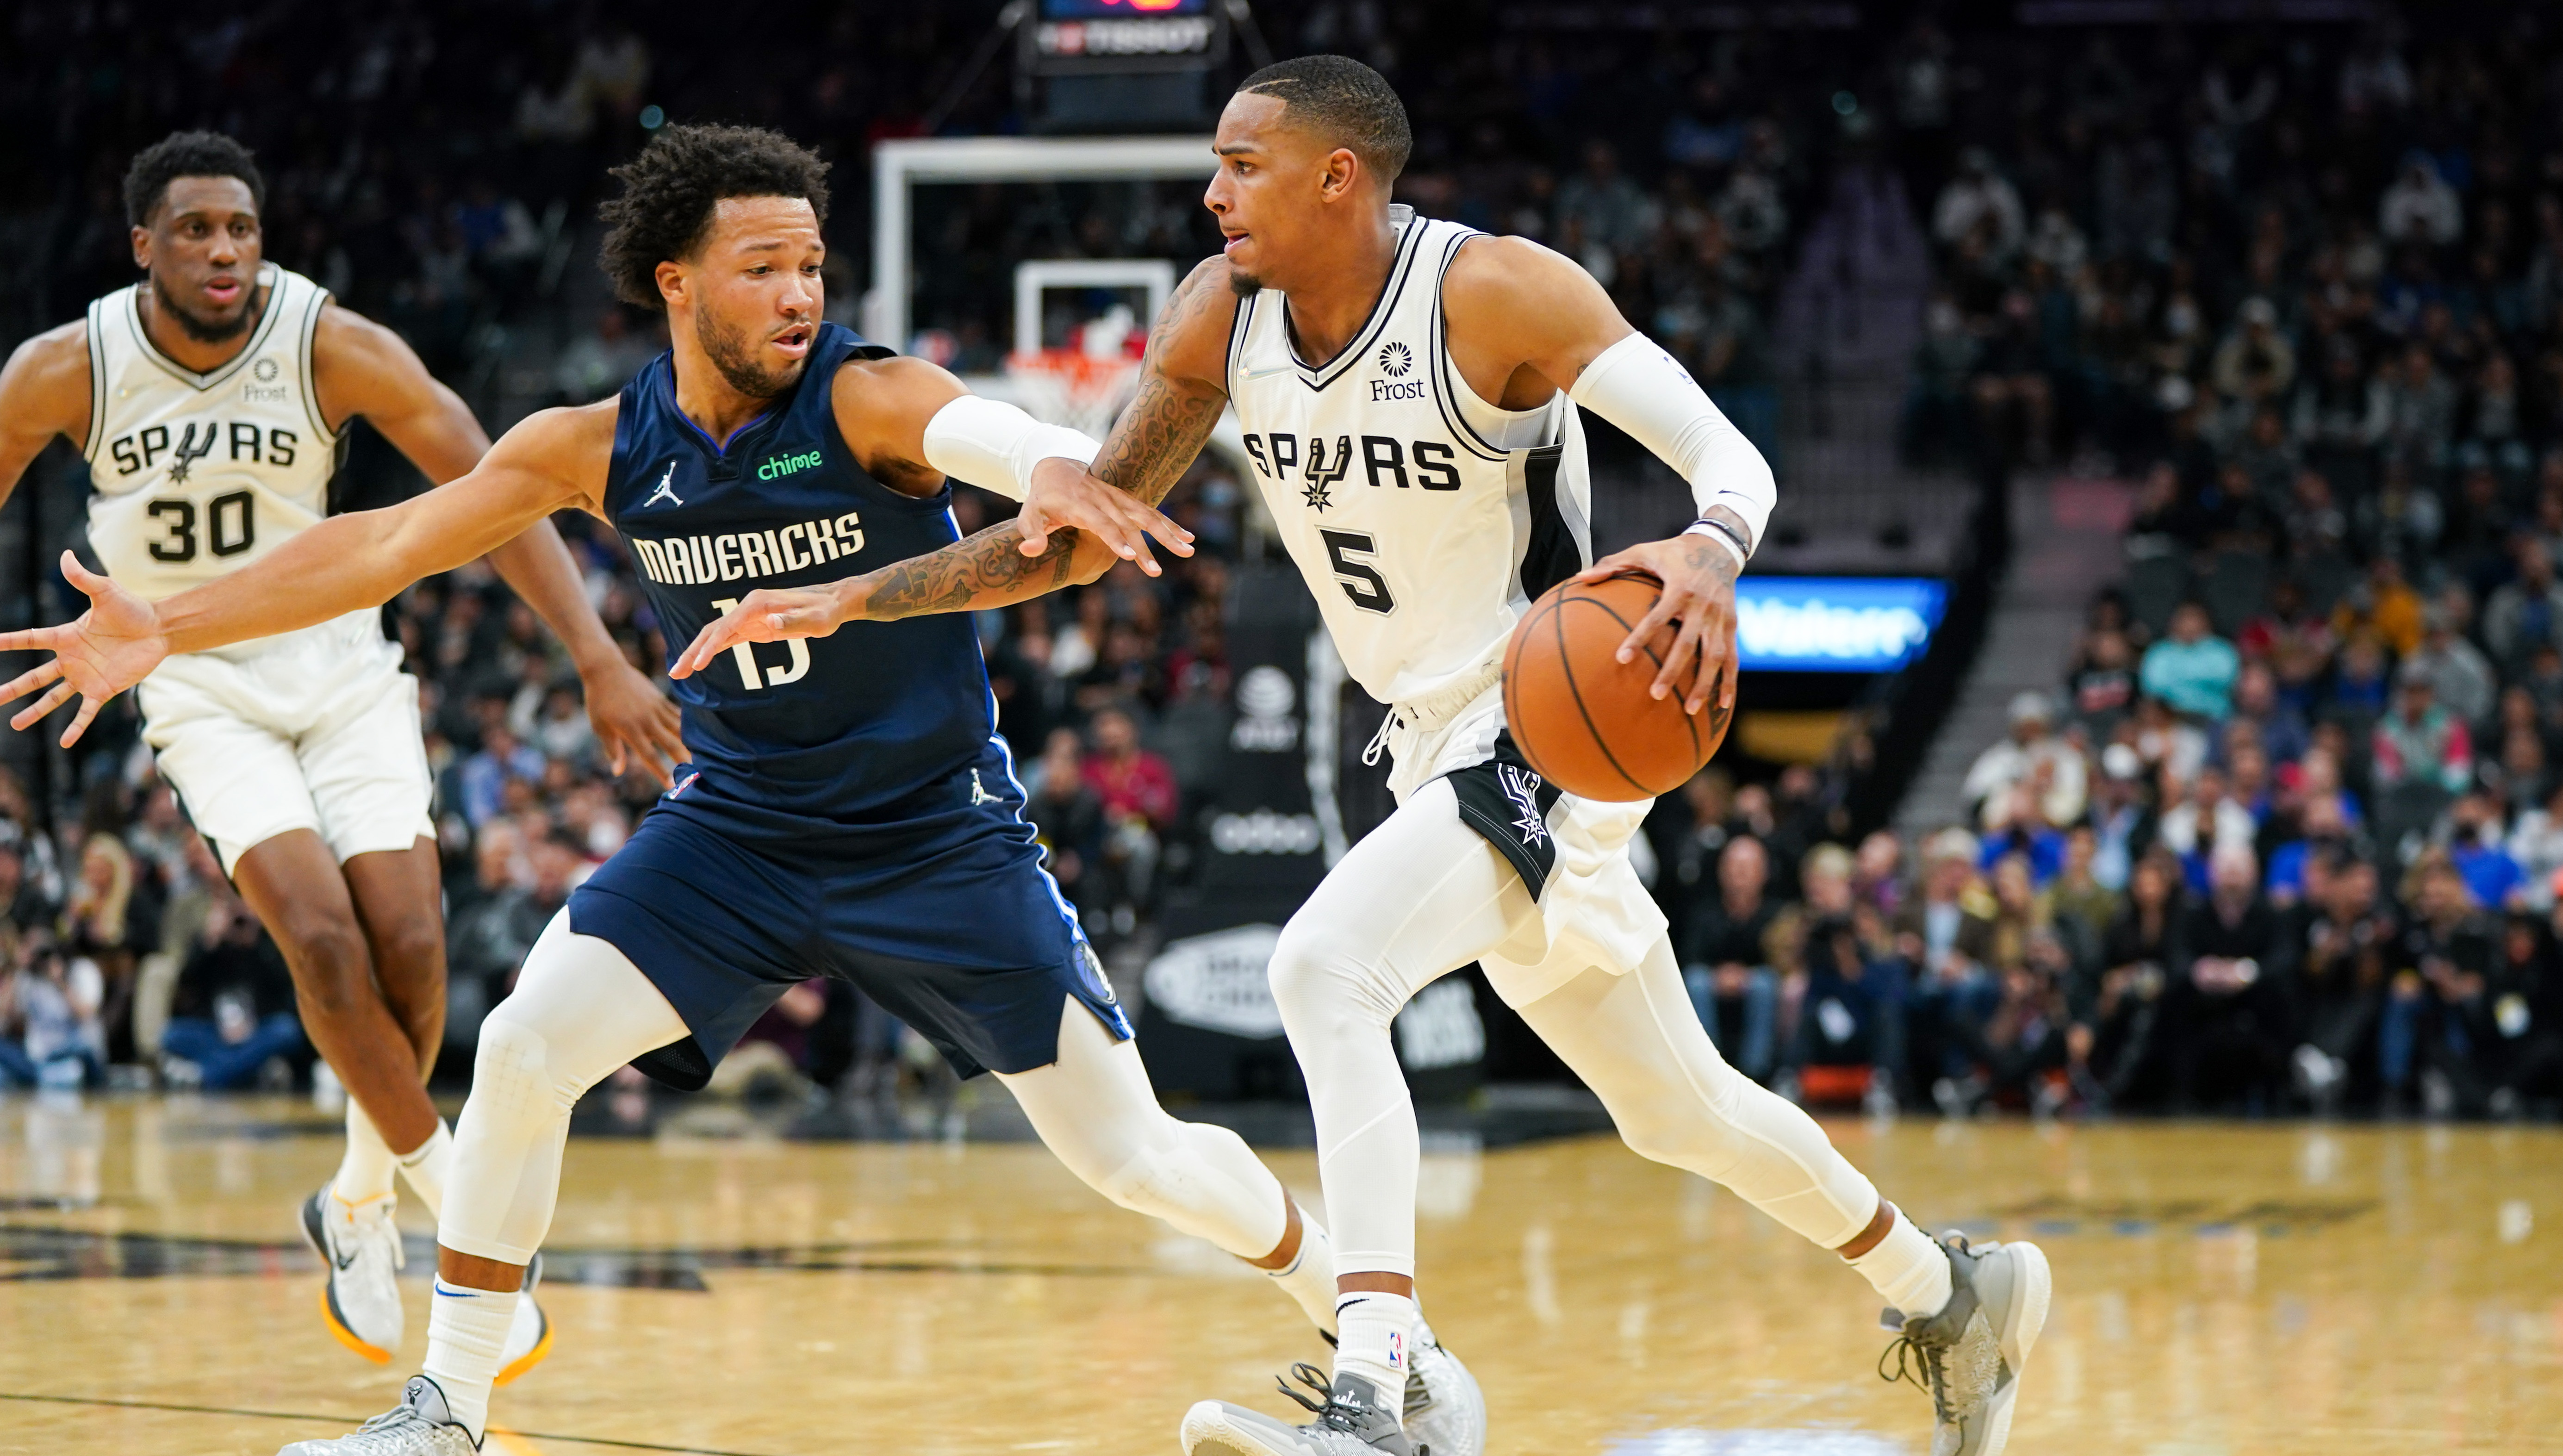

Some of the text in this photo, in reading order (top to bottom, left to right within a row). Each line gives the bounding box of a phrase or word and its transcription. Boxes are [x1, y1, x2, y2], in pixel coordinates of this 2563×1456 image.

[244, 383, 287, 402] Frost
[1369, 379, 1425, 401] Frost
[112, 422, 298, 485] SPURS
[758, 450, 822, 480] chime
[1244, 433, 1462, 514] SPURS
[147, 488, 255, 565] 30
[633, 512, 865, 585] MAVERICKS
[1314, 524, 1399, 618] 5
